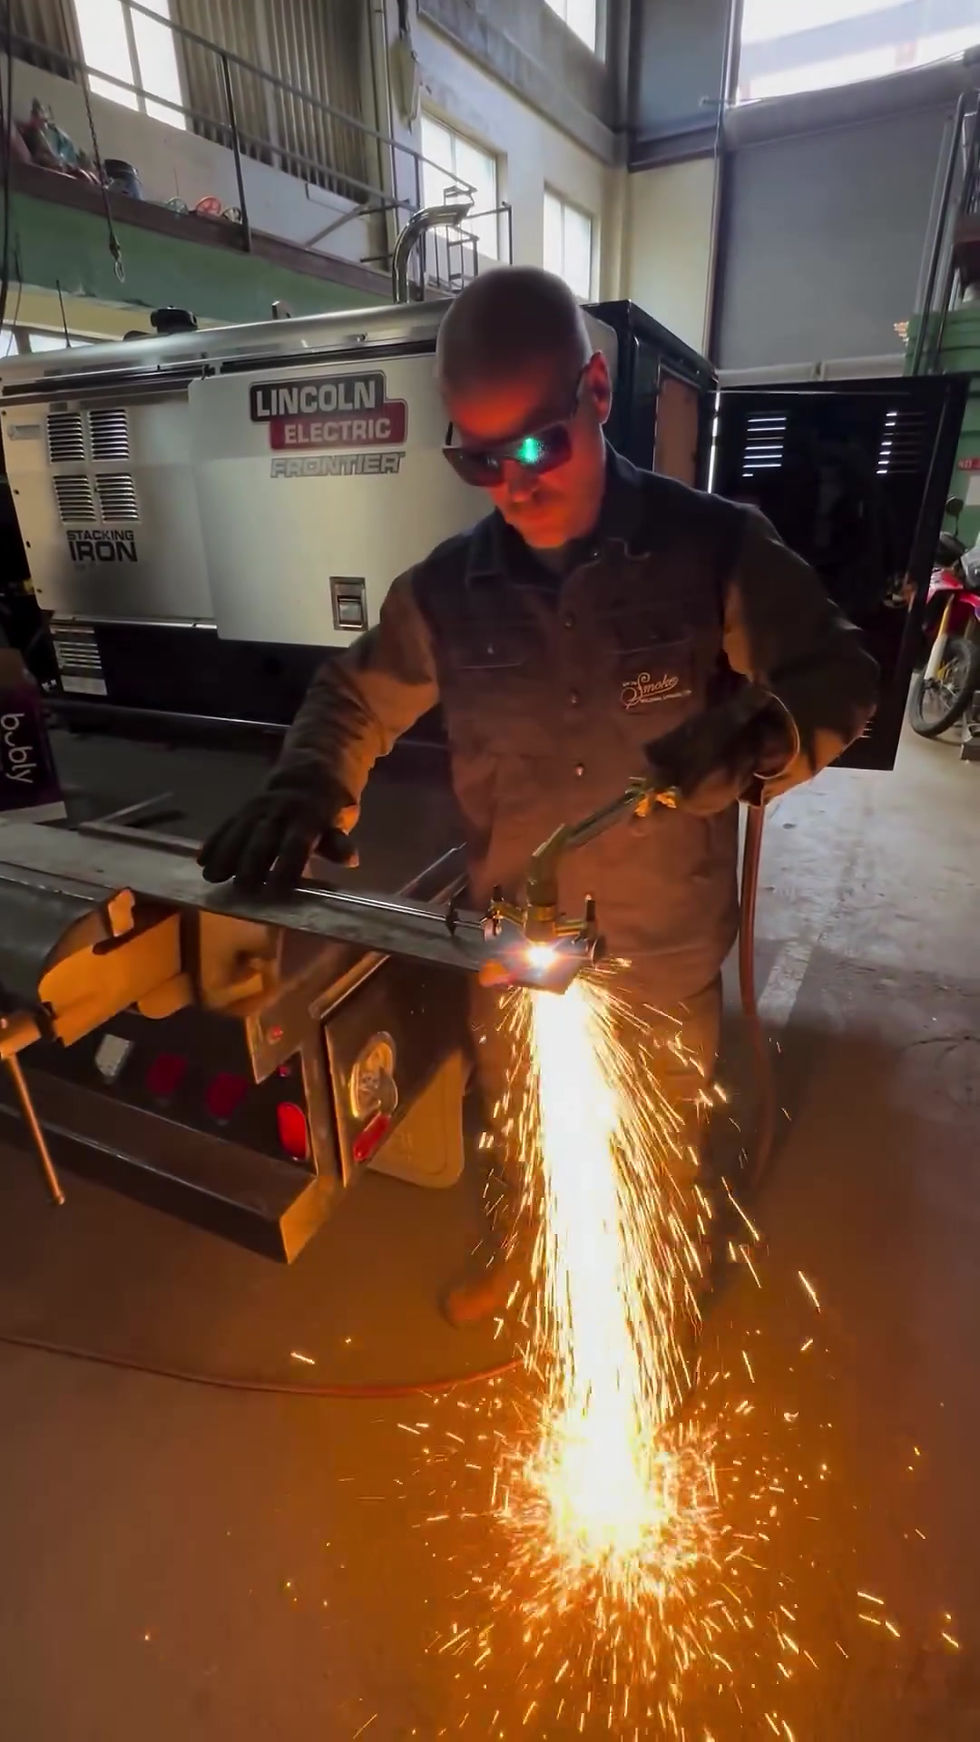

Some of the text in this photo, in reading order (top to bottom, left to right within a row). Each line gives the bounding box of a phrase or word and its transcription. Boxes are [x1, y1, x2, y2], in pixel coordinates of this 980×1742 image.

[256, 380, 376, 417] LINCOLN
[284, 418, 391, 444] ELECTRIC
[270, 453, 402, 478] FRONTIER
[66, 530, 134, 540] STACKING
[68, 541, 138, 562] IRON
[621, 672, 679, 709] Smoke
[1, 713, 37, 783] bubly
